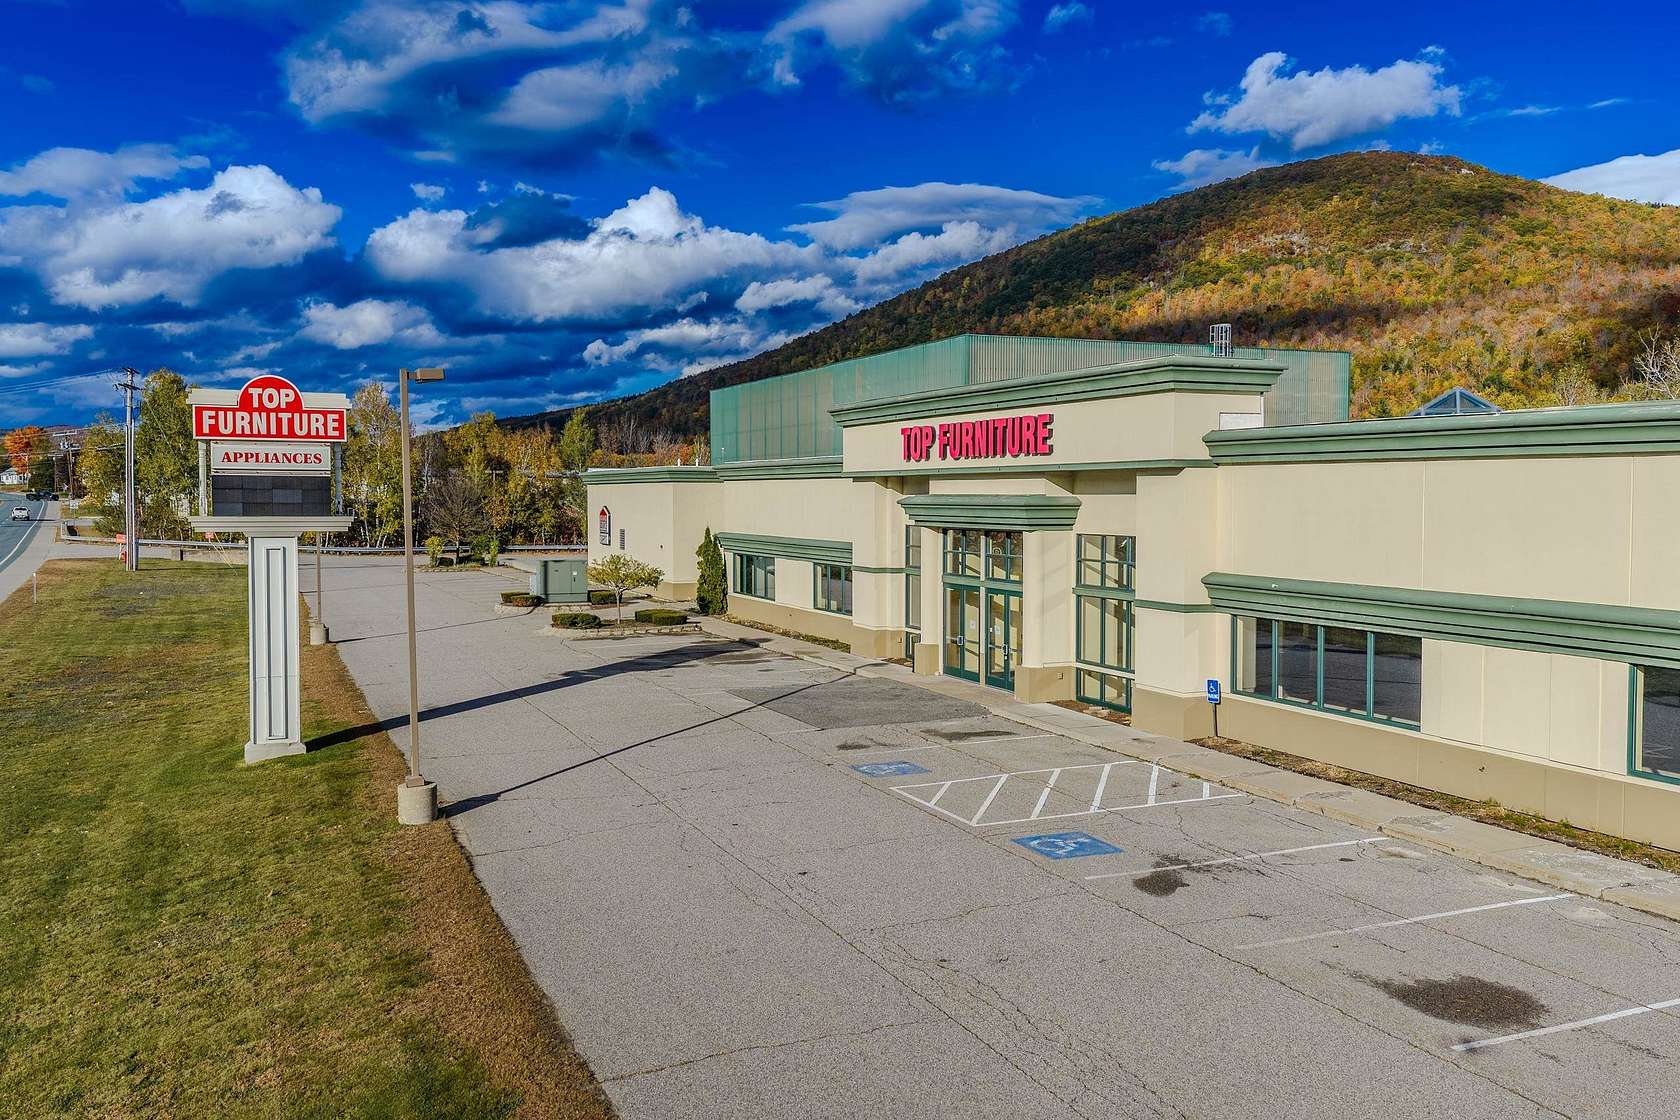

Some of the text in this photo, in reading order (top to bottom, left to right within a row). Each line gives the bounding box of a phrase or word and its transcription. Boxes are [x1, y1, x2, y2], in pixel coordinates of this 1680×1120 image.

[248, 387, 295, 409] TOP
[202, 410, 340, 437] FURNITURE
[901, 413, 1054, 462] TOP FURNITURE
[221, 451, 323, 465] APPLIANCES
